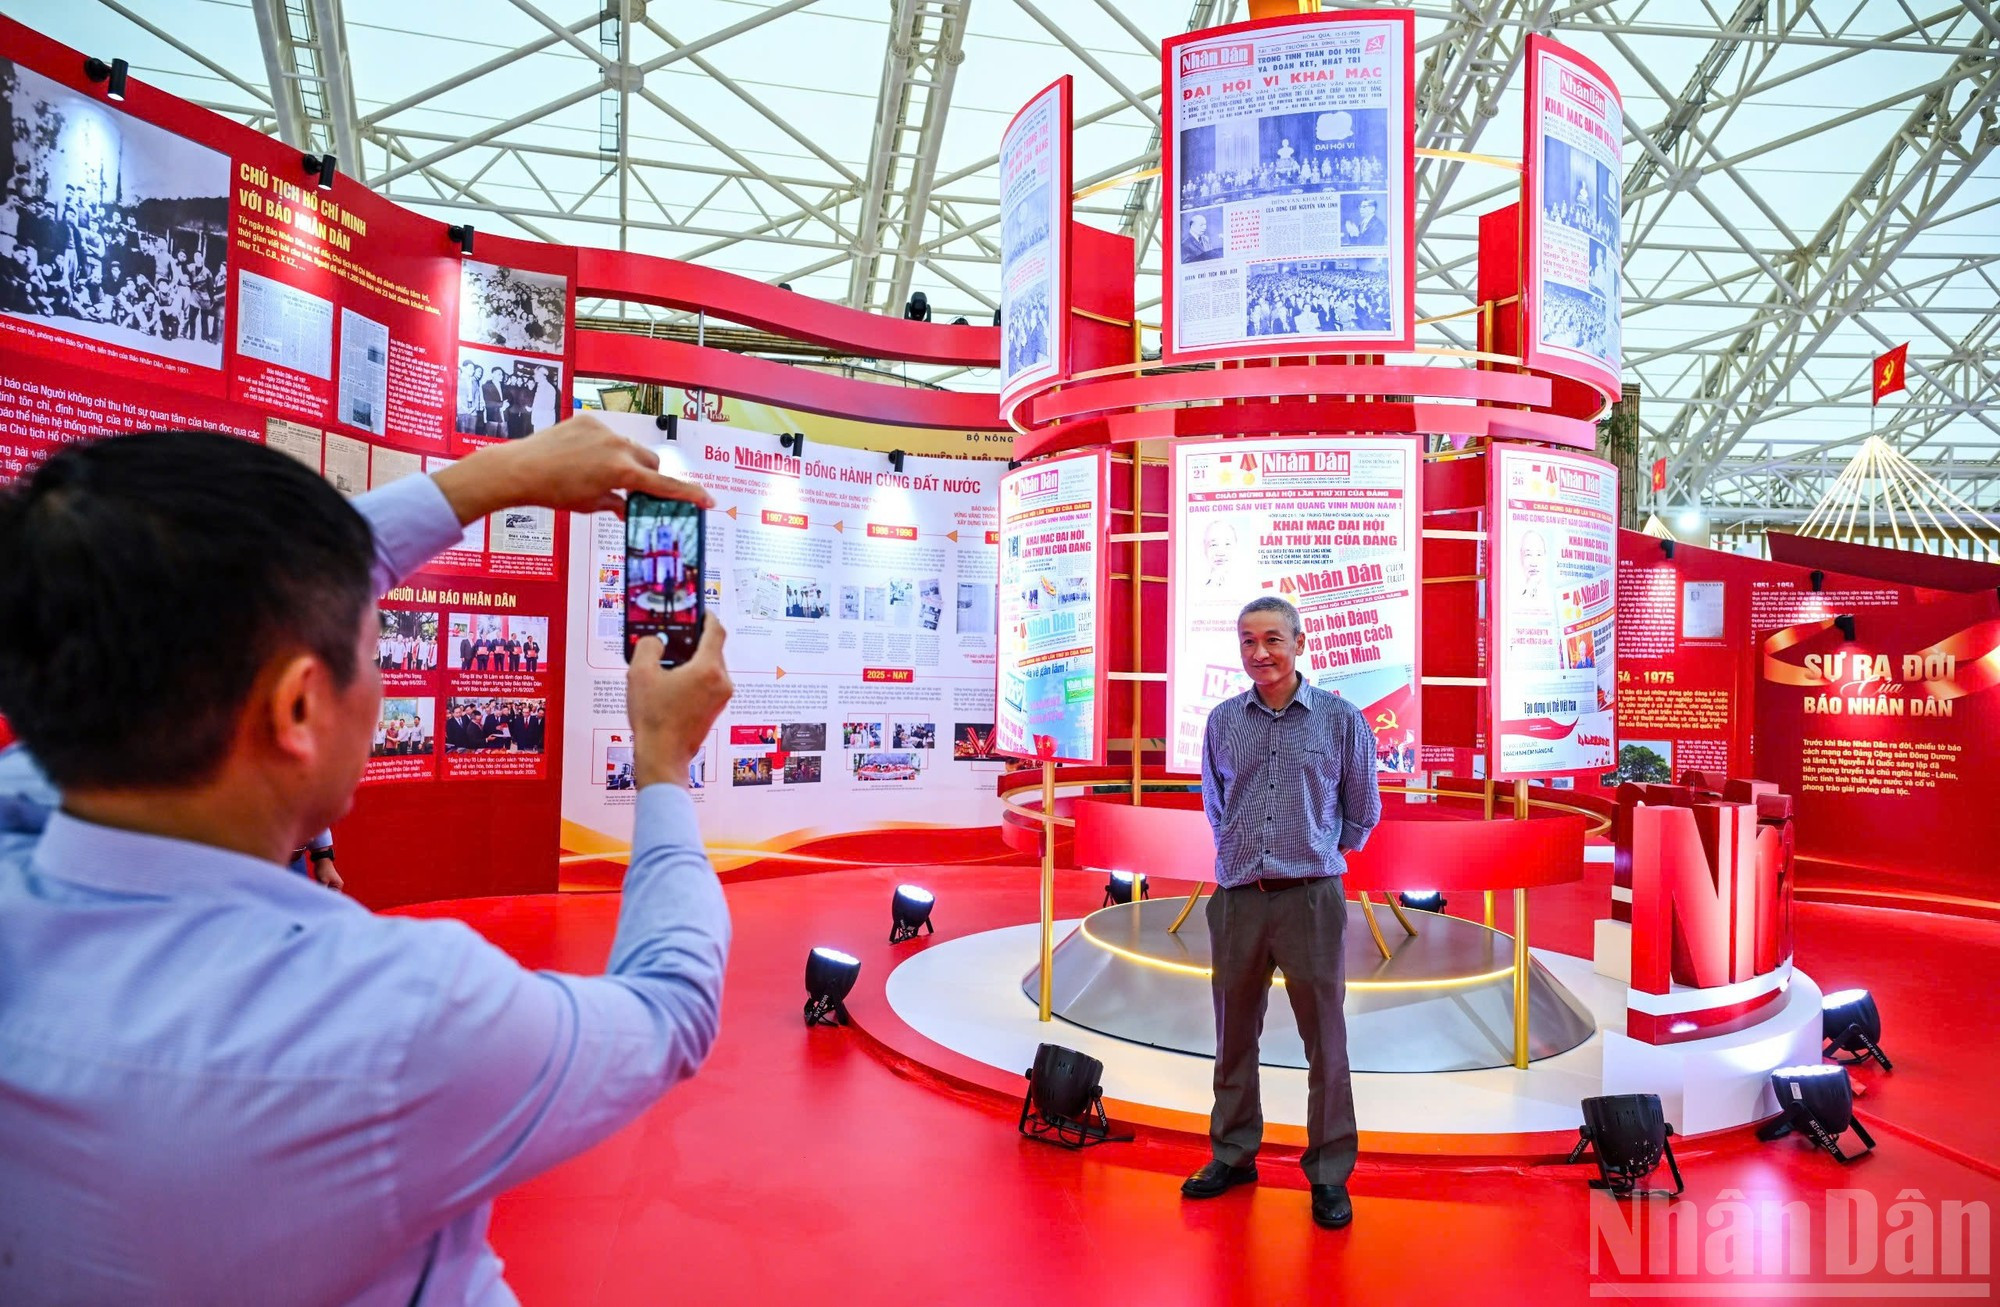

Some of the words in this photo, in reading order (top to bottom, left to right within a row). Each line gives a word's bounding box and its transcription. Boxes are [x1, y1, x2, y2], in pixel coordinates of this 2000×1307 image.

[1183, 49, 1218, 73] Nhân
[1220, 47, 1248, 63] Dân
[1258, 55, 1281, 64] TRONG
[1264, 76, 1278, 87] VI
[1291, 70, 1334, 83] KHAI
[240, 163, 268, 189] CHỦ
[272, 176, 299, 203] TỊCH
[303, 189, 318, 211] HỒ
[321, 200, 339, 222] CHÍ
[341, 210, 366, 236] MINH
[238, 215, 247, 225] Từ
[248, 220, 264, 232] ngày
[266, 226, 277, 236] Báo
[239, 189, 261, 212] VỚI
[266, 199, 292, 225] BÁO
[329, 227, 350, 251] DÂN
[237, 240, 251, 250] như
[238, 228, 251, 238] thời
[252, 233, 266, 244] gian
[4, 377, 20, 389] báo
[23, 382, 38, 393] của
[41, 385, 65, 399] Người
[68, 391, 92, 407] không
[94, 397, 106, 407] chỉ
[108, 400, 121, 411] thu
[123, 403, 136, 414] hút
[138, 408, 148, 418] sự
[150, 410, 169, 420] quan
[171, 412, 186, 424] tâm
[188, 416, 201, 427] của
[203, 420, 217, 431] bạn
[219, 422, 232, 435] đọc
[233, 426, 246, 436] qua
[248, 429, 259, 439] các
[19, 395, 32, 407] tôn
[56, 403, 73, 416] định
[77, 408, 102, 423] hướng
[106, 414, 121, 425] của
[124, 417, 132, 427] tờ
[136, 420, 151, 430] báo
[10, 423, 27, 436] Chủ
[29, 427, 45, 440] tịch
[48, 430, 59, 442] Hồ
[967, 434, 979, 443] BỘ
[985, 434, 1013, 443] NÔNG
[14, 446, 28, 457] bài
[705, 445, 729, 462] Báo
[805, 460, 836, 480] ĐỒNG
[840, 463, 871, 484] HÀNH
[876, 472, 909, 488] CÙNG
[914, 475, 939, 491] ĐẤT
[944, 477, 980, 493] NƯỚC
[1264, 453, 1309, 472] Nhân
[1315, 452, 1348, 470] Dân
[1041, 472, 1057, 490] Dân
[1193, 470, 1206, 478] 21
[1513, 477, 1524, 485] 26
[1273, 520, 1303, 531] KHAI
[1314, 535, 1331, 545] XII
[1296, 569, 1344, 593] Nhân
[1347, 564, 1382, 584] Dân
[388, 586, 413, 602] NGƯỜI
[416, 587, 436, 603] LÀM
[440, 589, 459, 604] BÁO
[462, 590, 491, 606] NHÂN
[494, 592, 516, 607] DÂN
[1053, 612, 1075, 632] Dân
[1304, 616, 1324, 633] Đại
[1326, 612, 1346, 631] hội
[1347, 608, 1378, 625] Đảng
[1308, 633, 1322, 651] và
[1324, 631, 1362, 650] phong
[1329, 649, 1349, 667] Chí
[1350, 645, 1381, 664] Minh
[1804, 652, 1847, 682] SỰ
[1853, 654, 1892, 681] RA
[1902, 649, 1955, 681] ĐỜI
[893, 671, 908, 679] NAY
[1644, 672, 1674, 684] 1975
[1804, 693, 1842, 714] BÁO
[1848, 694, 1903, 715] NHÂN
[1910, 696, 1952, 717] DÂN
[1853, 740, 1871, 748] Nhân
[1874, 740, 1888, 748] Dân
[1915, 742, 1936, 751] nhiều
[1938, 743, 1946, 751] tờ
[1829, 758, 1836, 766] tụ
[1838, 758, 1865, 767] Nguyễn
[1876, 759, 1894, 767] Quốc
[1896, 761, 1914, 769] sáng
[1916, 761, 1928, 770] lập
[1803, 784, 1824, 792] phong
[1826, 784, 1840, 792] trào
[1842, 785, 1855, 793] giải
[1857, 786, 1879, 794] phóng
